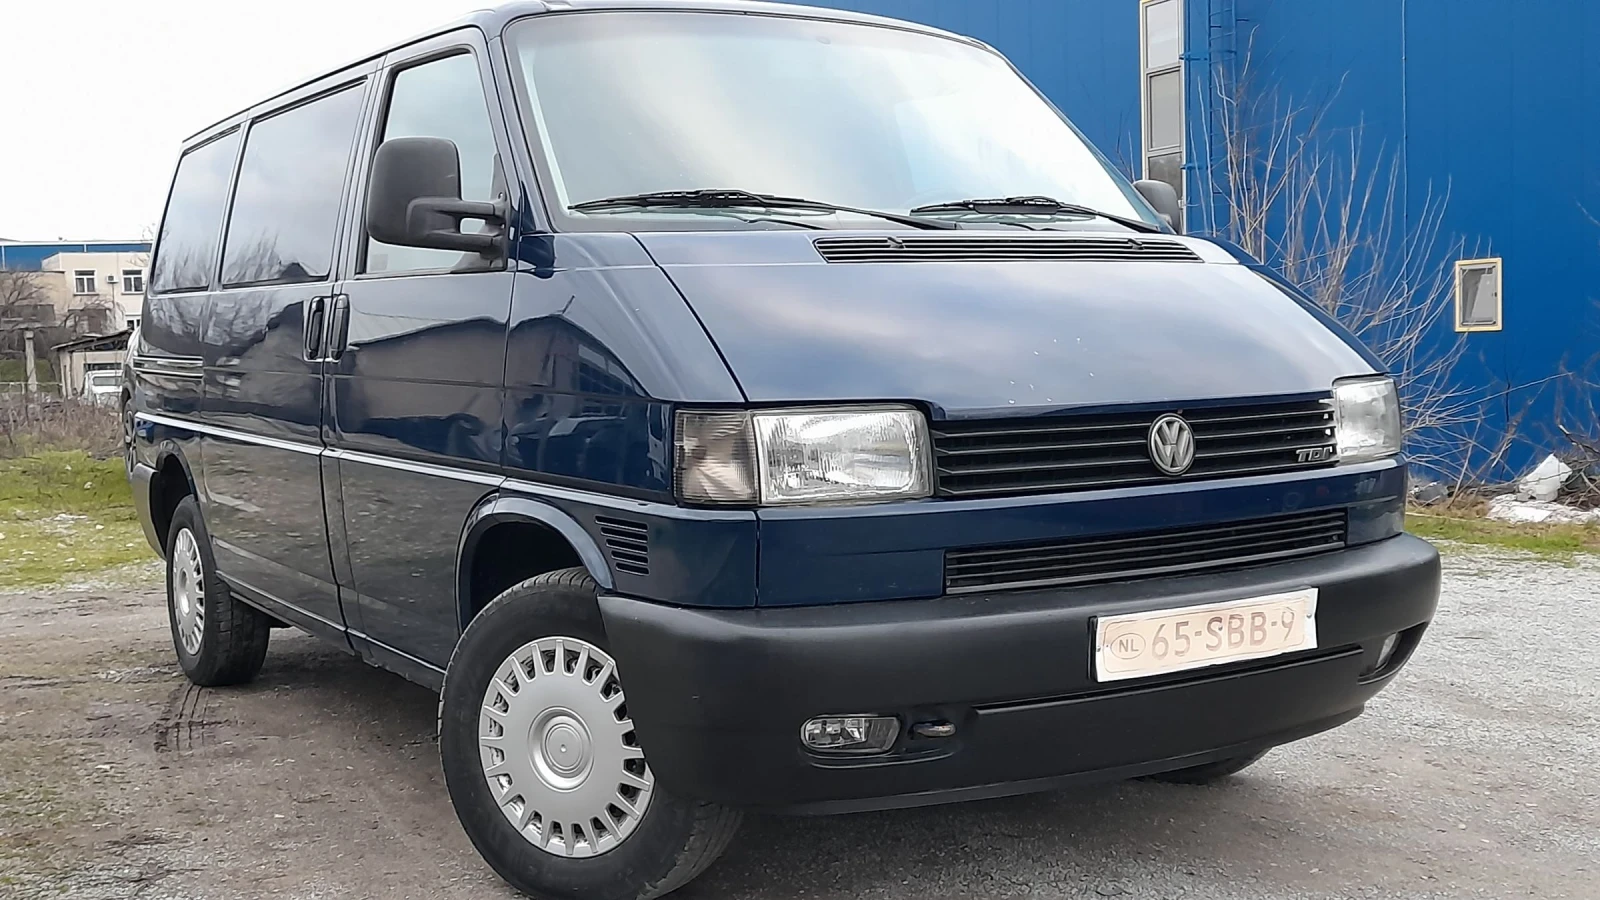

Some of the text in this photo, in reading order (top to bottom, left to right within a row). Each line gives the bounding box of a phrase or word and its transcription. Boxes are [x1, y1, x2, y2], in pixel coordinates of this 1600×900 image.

[1152, 418, 1193, 473] VW
[1296, 447, 1333, 463] TDI
[1118, 608, 1296, 660] NL 65-SBB-9
